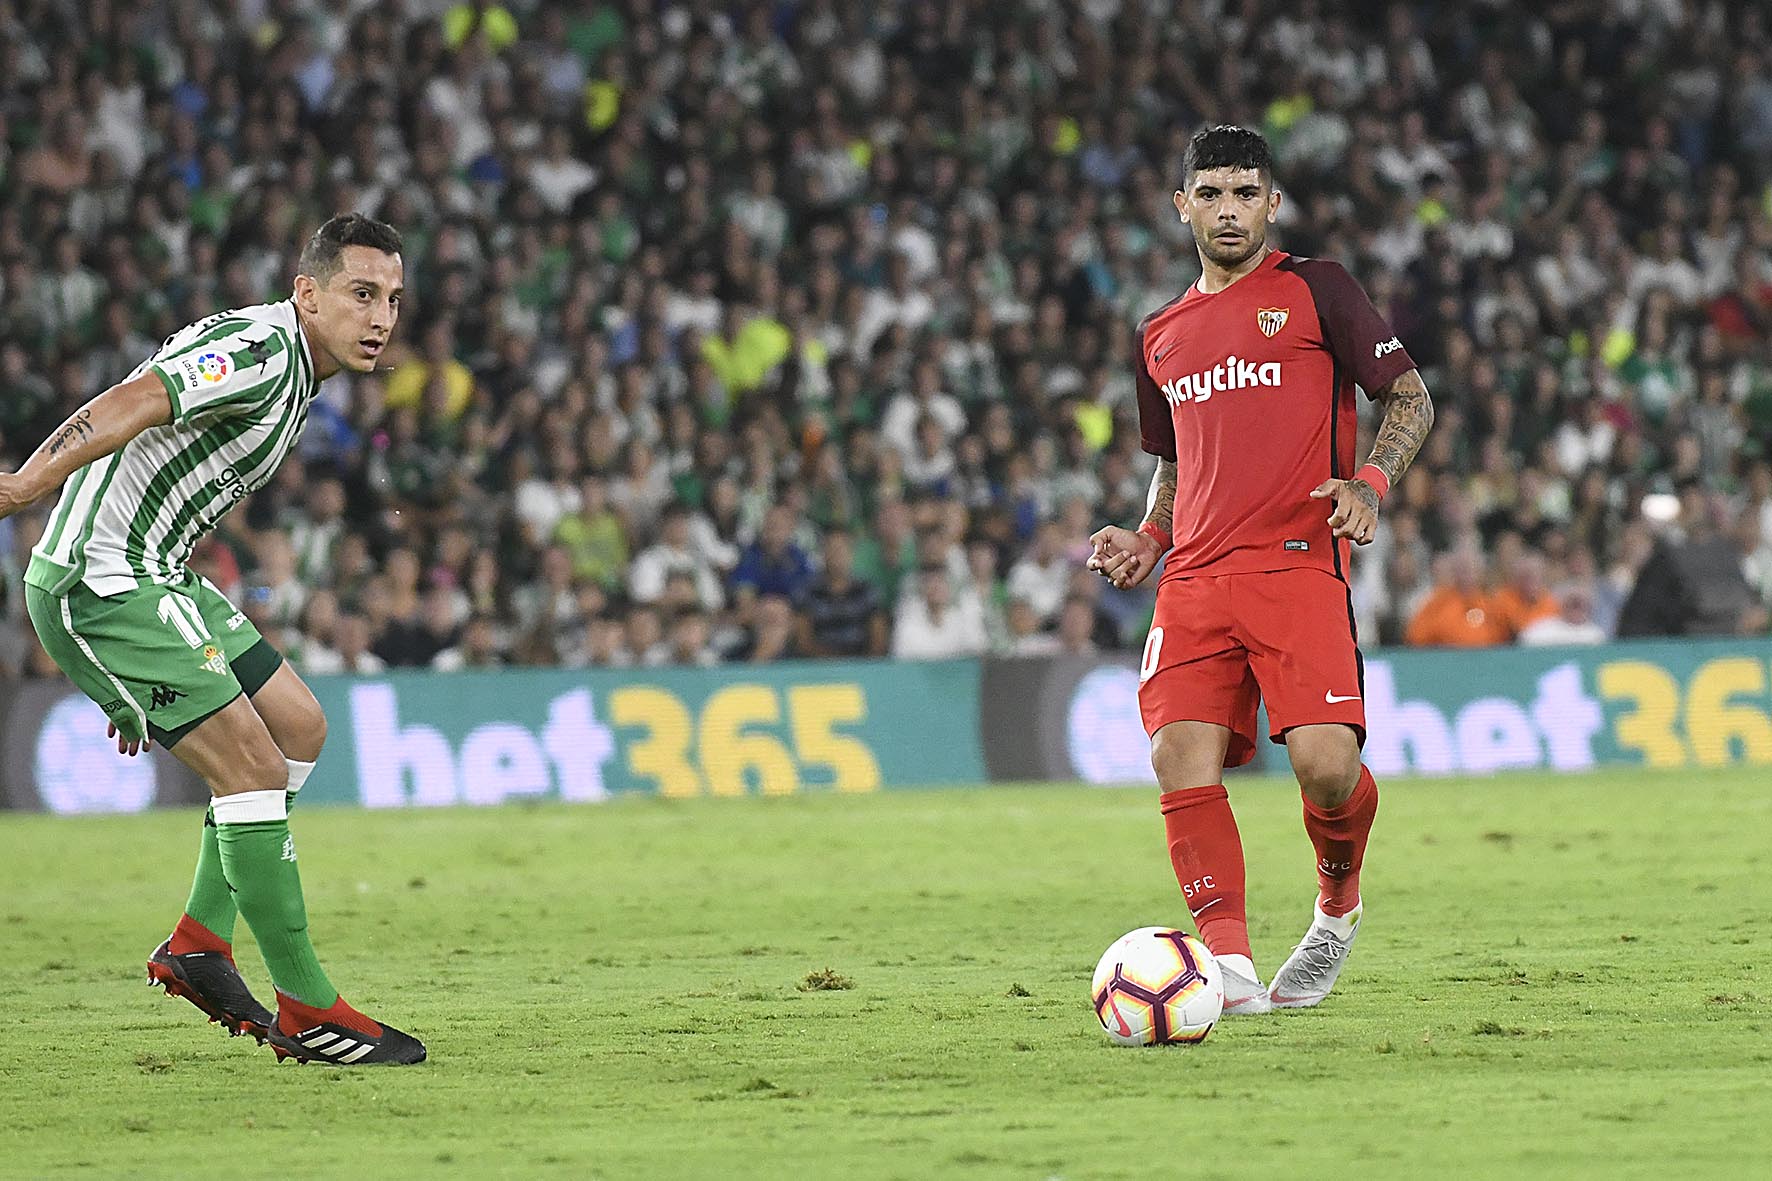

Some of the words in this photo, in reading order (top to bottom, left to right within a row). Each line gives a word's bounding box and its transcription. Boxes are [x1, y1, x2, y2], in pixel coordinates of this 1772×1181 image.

[349, 683, 882, 807] bet365
[1322, 857, 1350, 870] SFC
[1183, 875, 1216, 898] SFC
